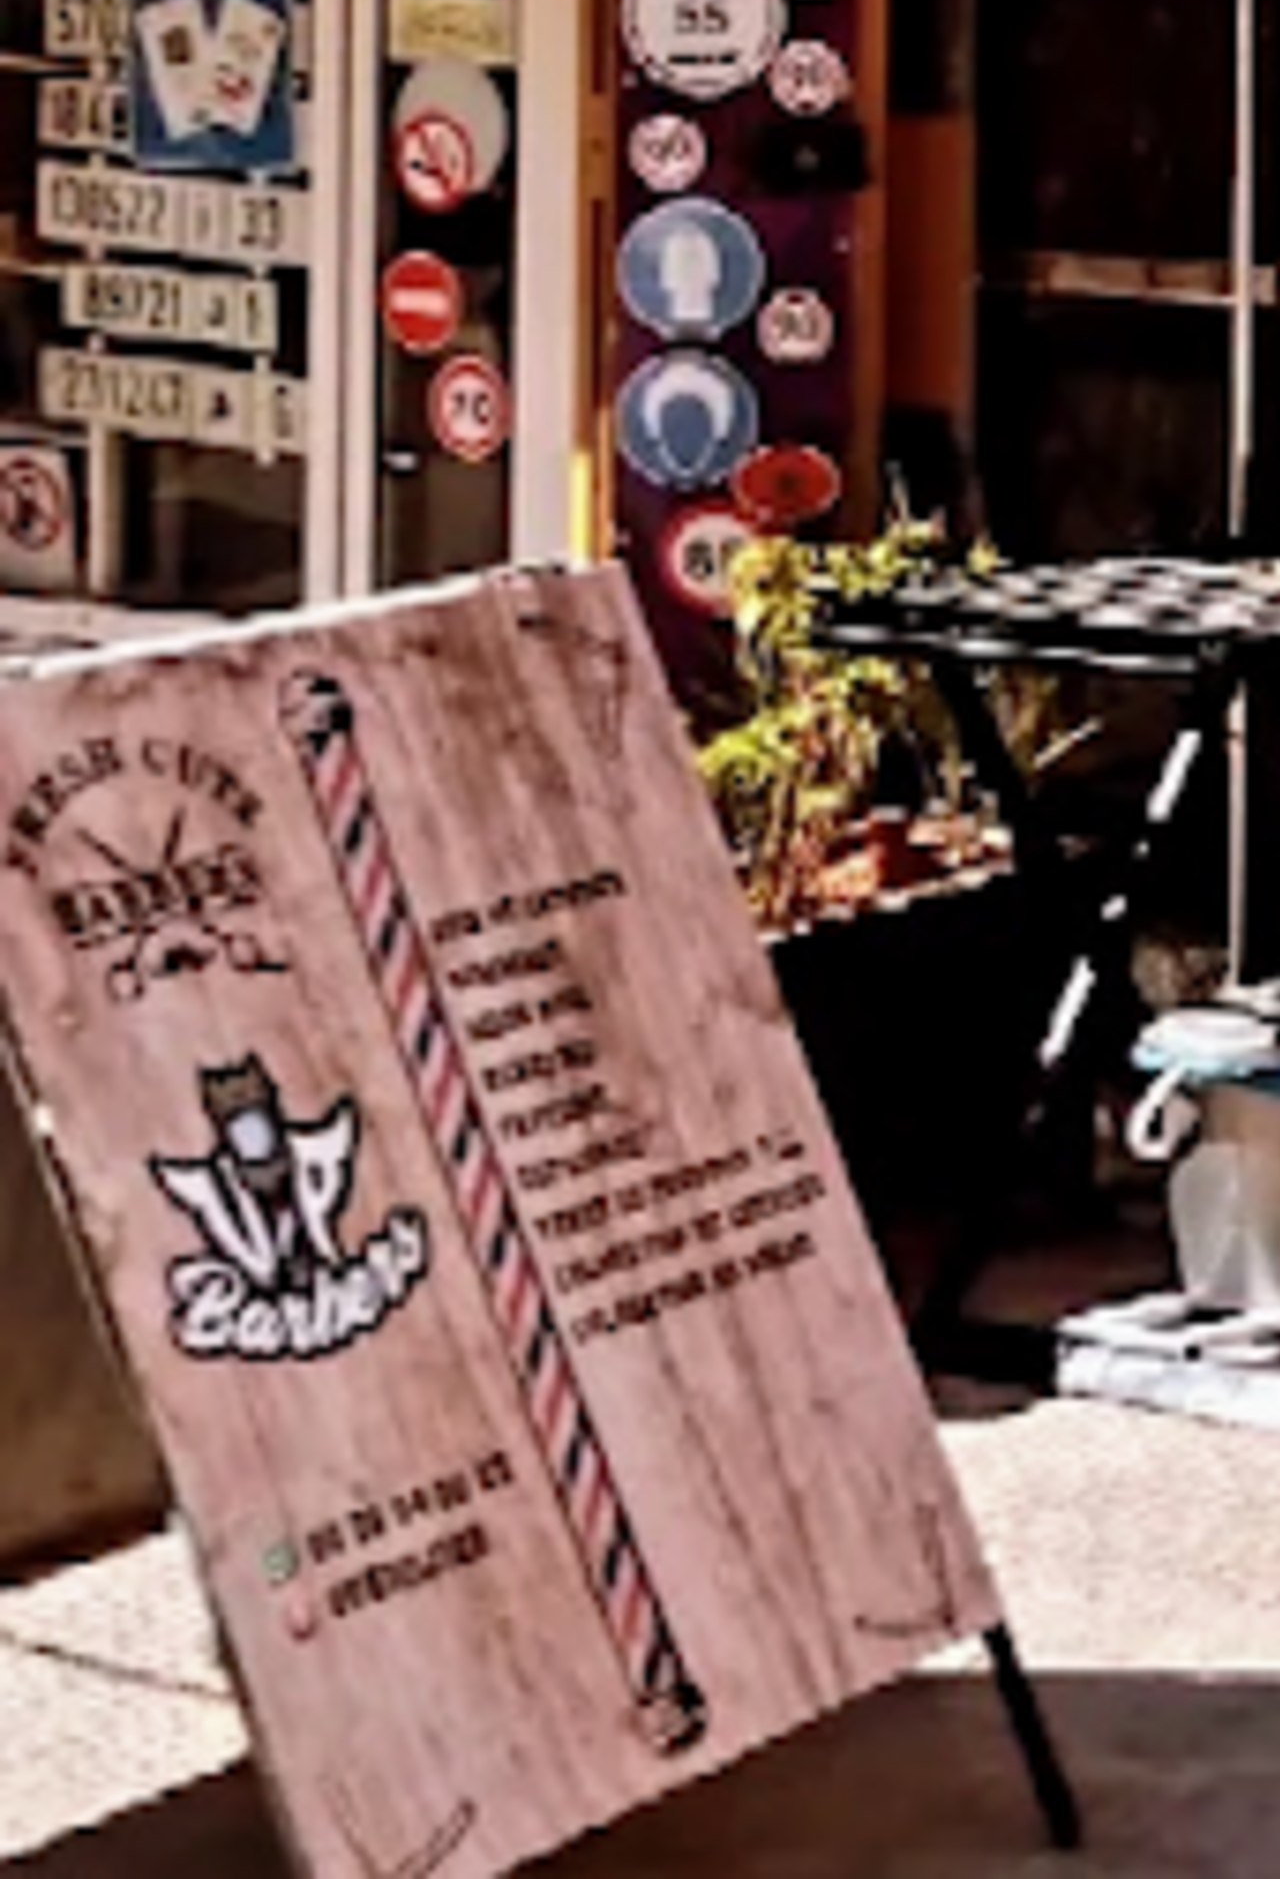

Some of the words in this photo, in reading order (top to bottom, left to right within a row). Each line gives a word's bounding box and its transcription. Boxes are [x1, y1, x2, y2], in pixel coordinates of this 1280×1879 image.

[5, 735, 124, 879] FRESH
[141, 734, 265, 830] CUTS
[166, 1207, 428, 1362] Barbers
